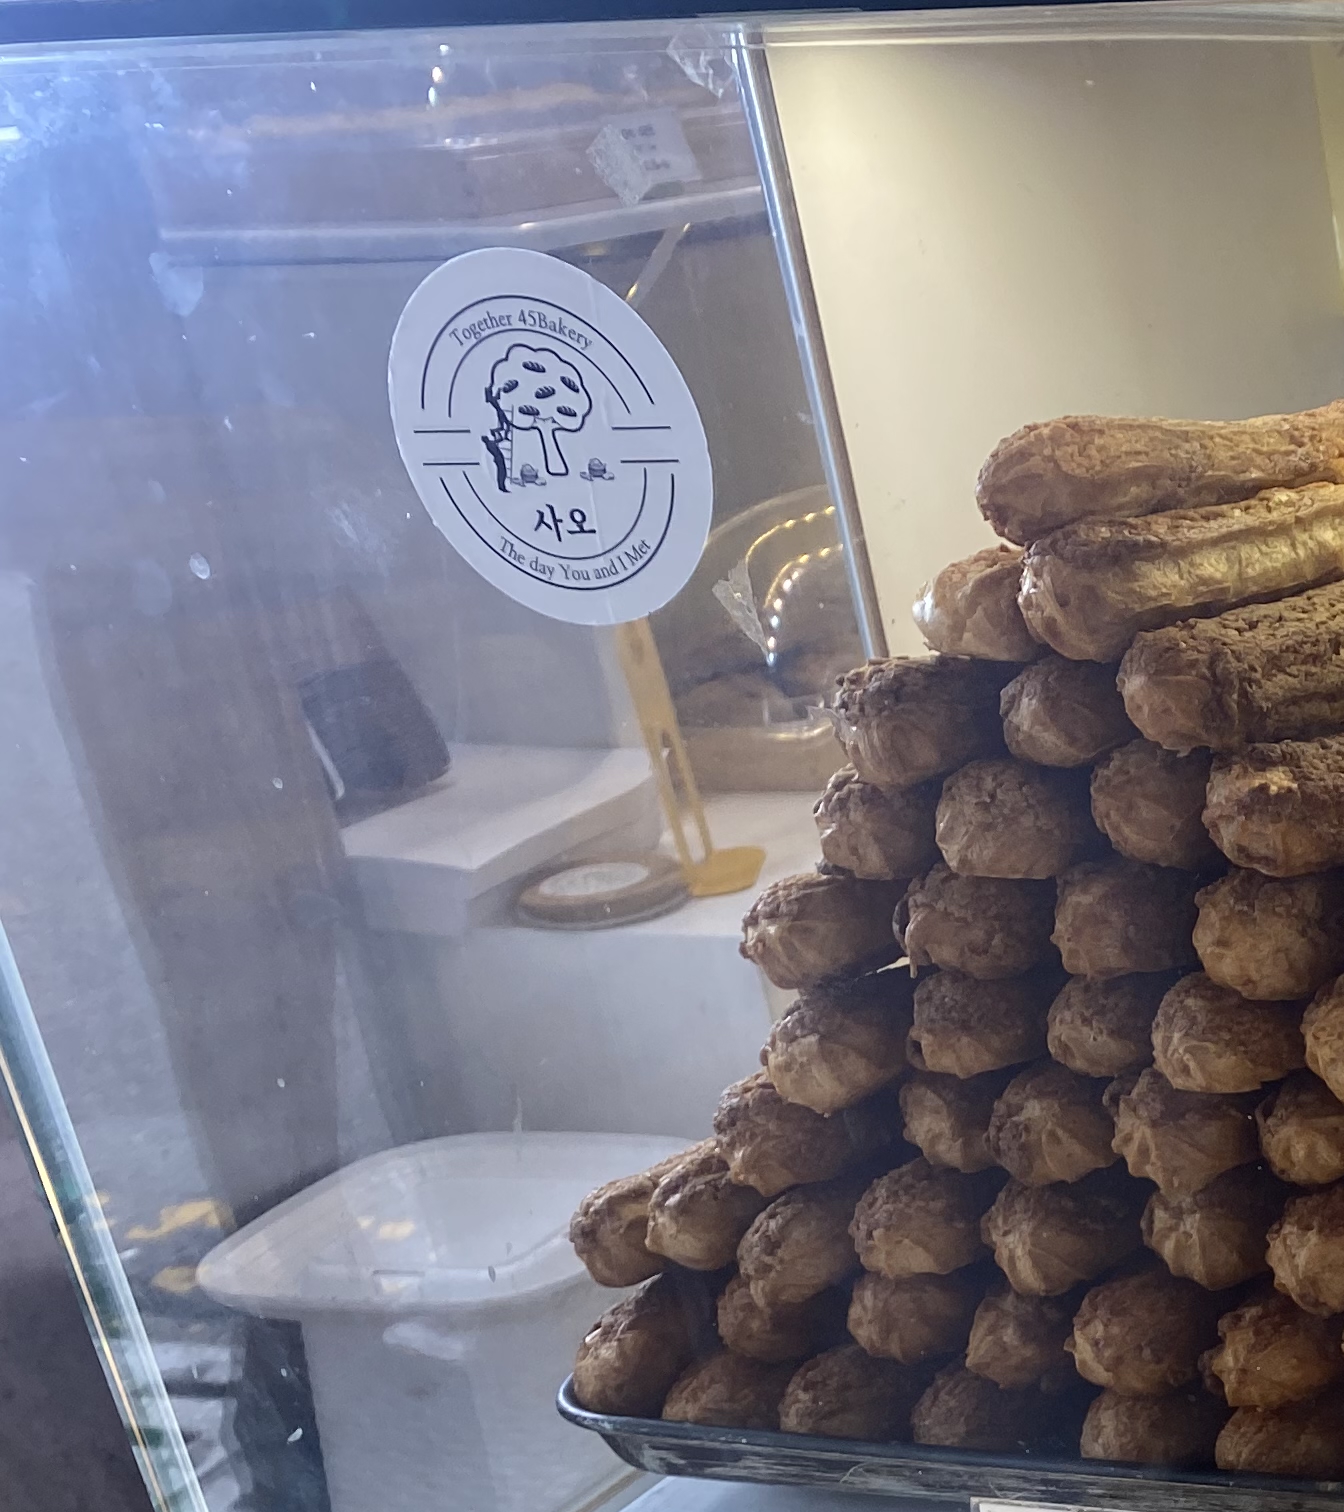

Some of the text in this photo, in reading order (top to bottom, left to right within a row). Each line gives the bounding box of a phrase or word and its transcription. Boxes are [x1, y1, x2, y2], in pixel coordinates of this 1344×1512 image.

[449, 309, 593, 350] Together 45Bakery
[534, 503, 596, 542] 사오
[500, 536, 651, 581] The day You and I Met
